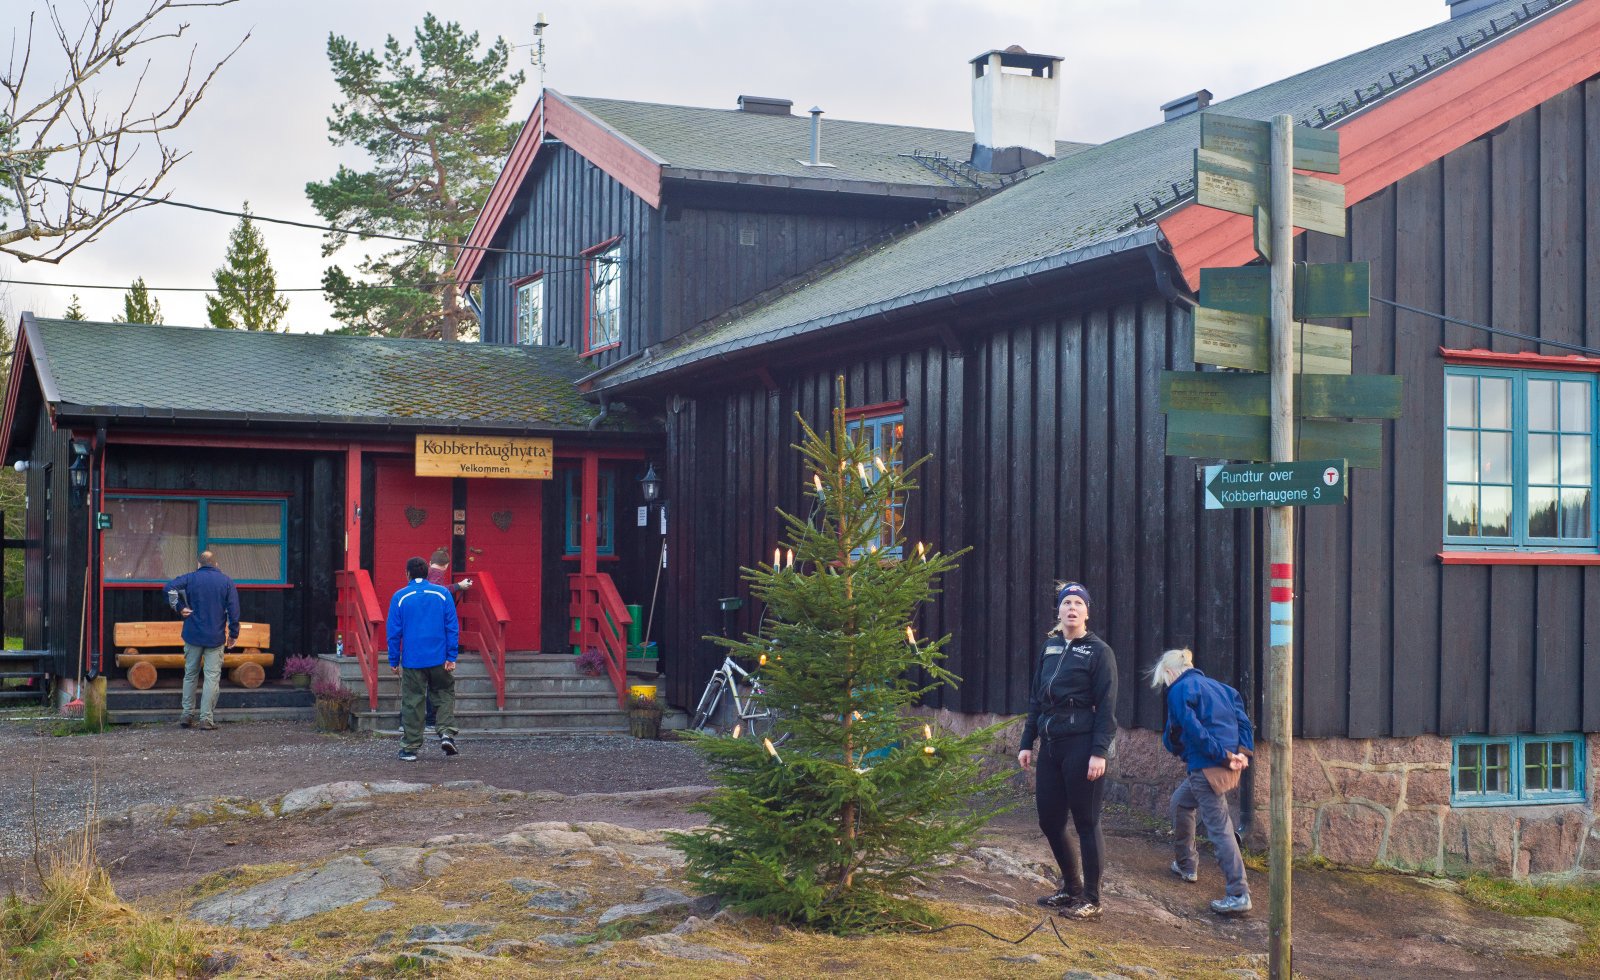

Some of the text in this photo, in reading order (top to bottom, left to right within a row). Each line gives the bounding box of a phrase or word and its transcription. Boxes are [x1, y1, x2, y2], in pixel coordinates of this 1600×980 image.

[423, 439, 547, 461] Kobberhaughytta
[460, 463, 510, 473] Velkommen
[1221, 470, 1294, 483] Rundtur over
[1326, 472, 1335, 482] T
[1221, 487, 1321, 502] Kobberhaugene 3
